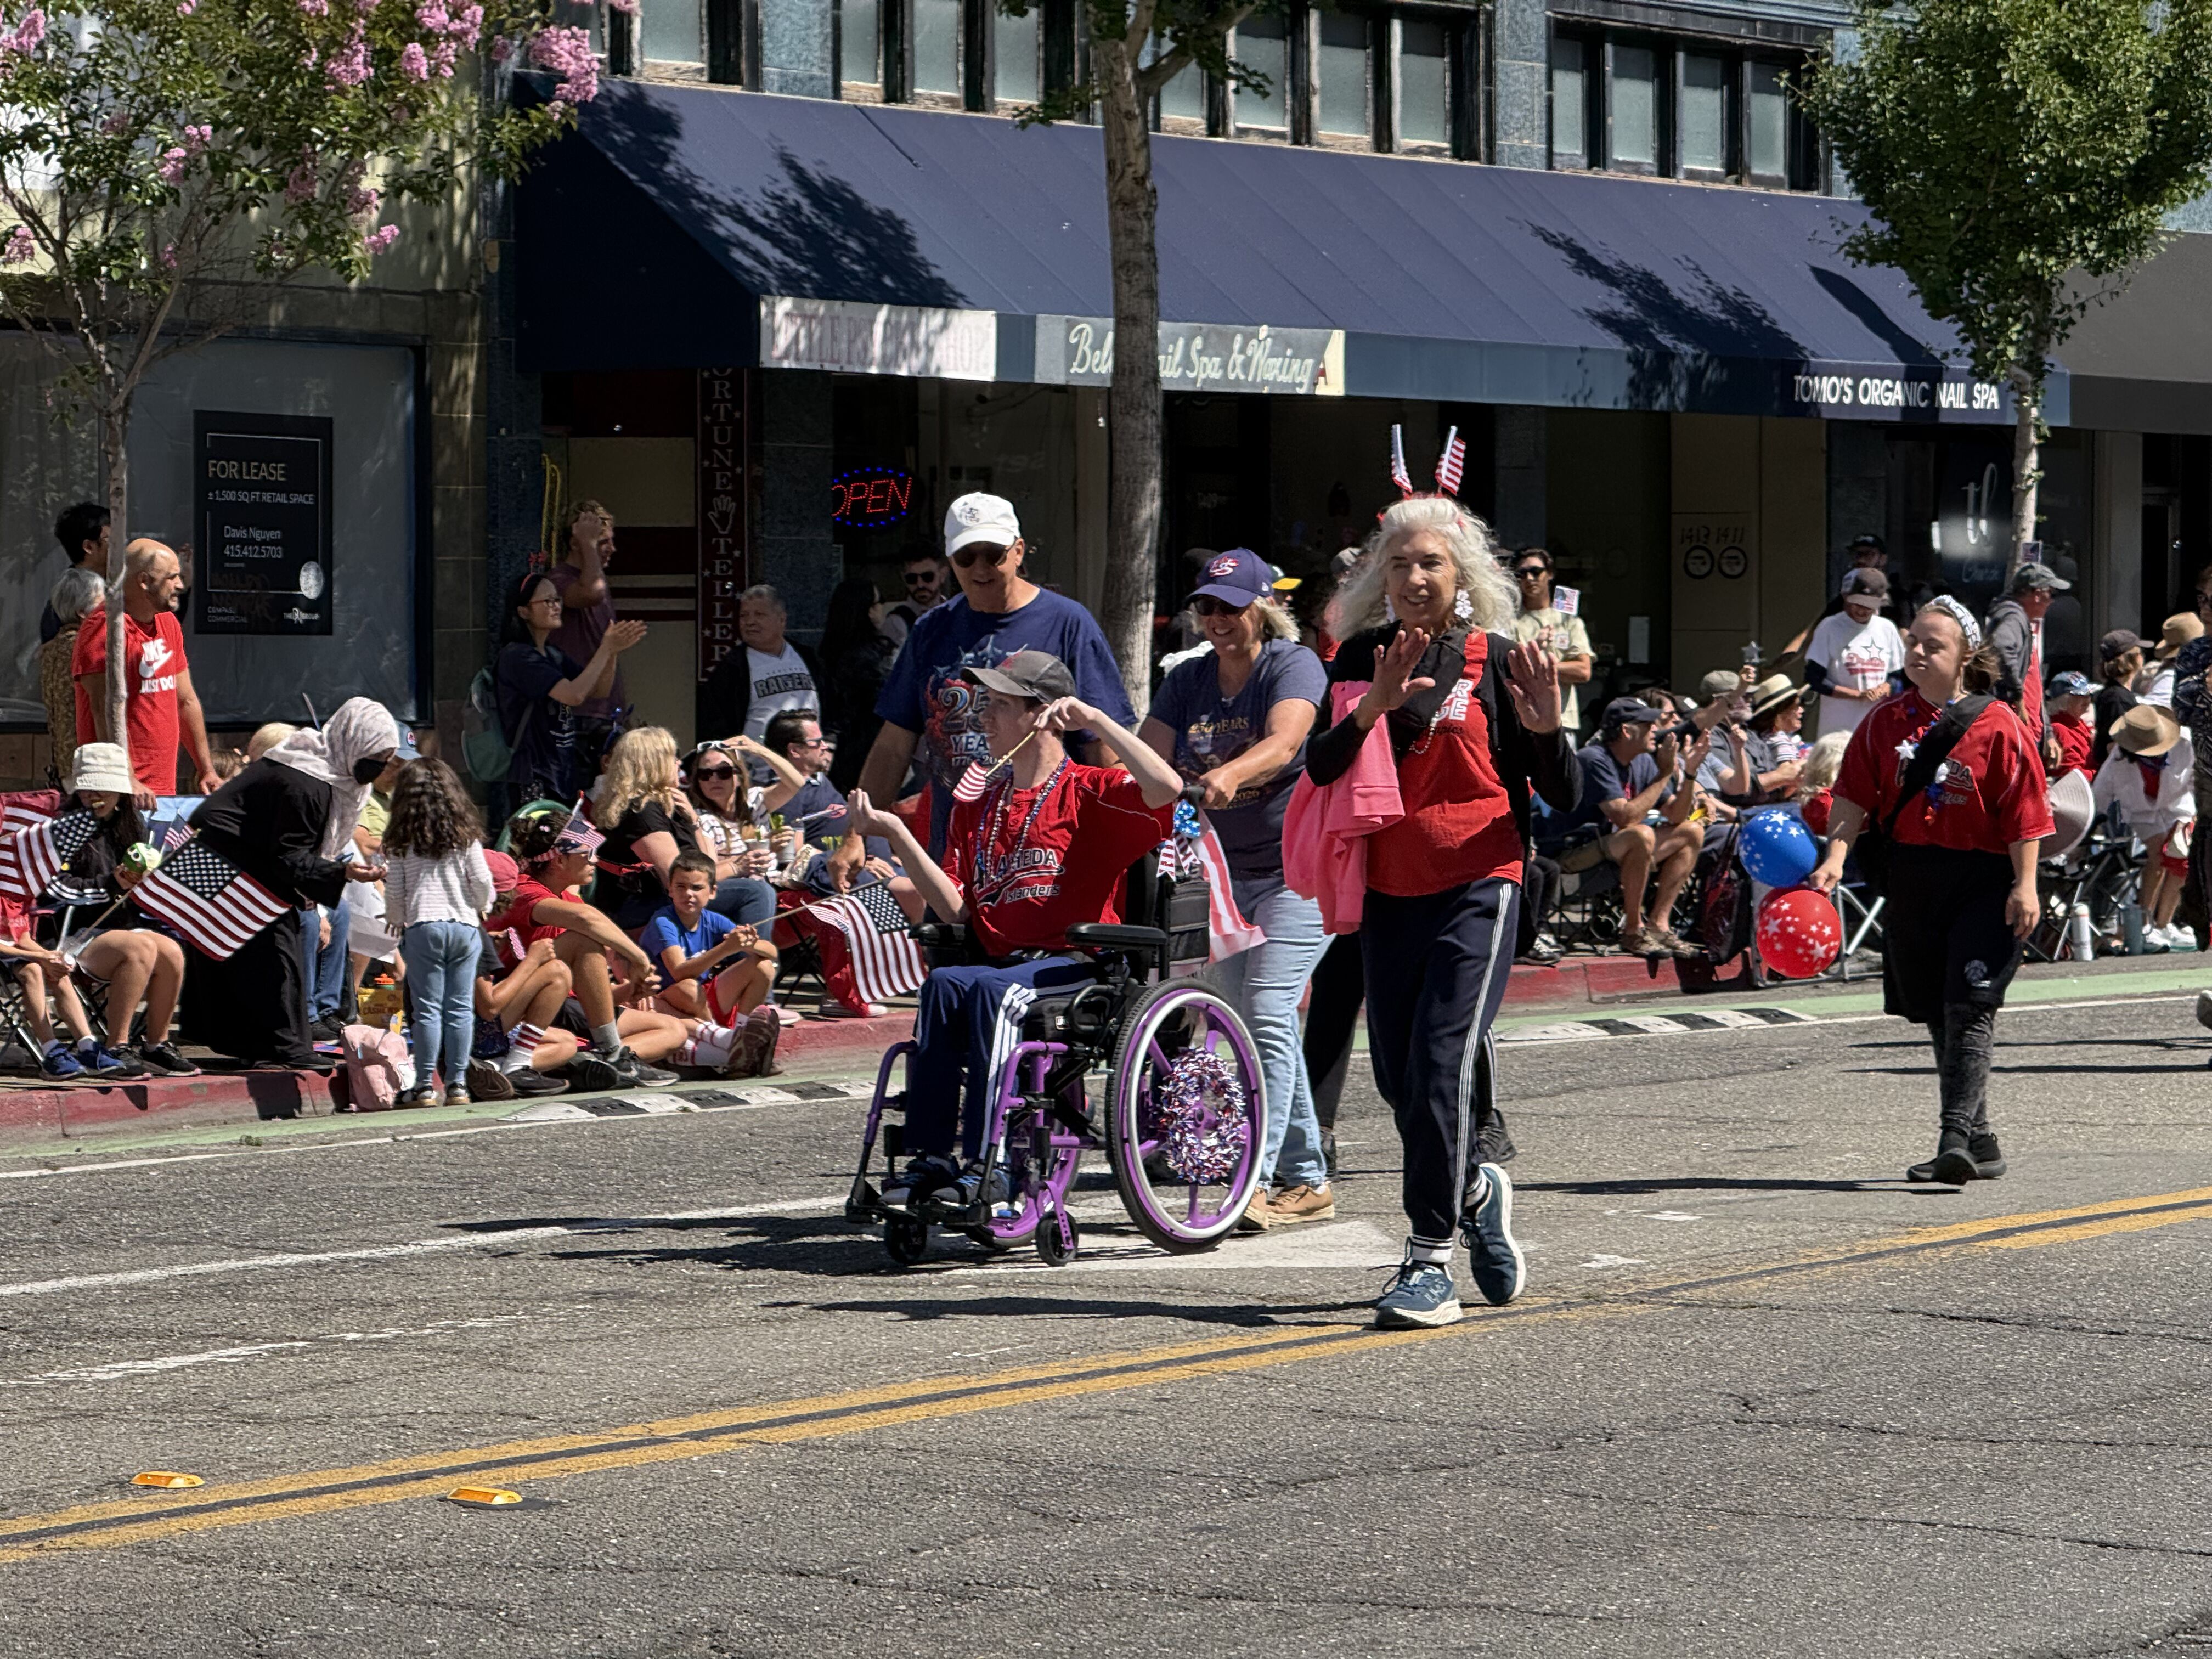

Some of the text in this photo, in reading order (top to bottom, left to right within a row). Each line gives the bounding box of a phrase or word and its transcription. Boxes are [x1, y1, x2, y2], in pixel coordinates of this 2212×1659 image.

[1158, 337, 1183, 378] ail
[1186, 335, 1222, 388] Spa
[1227, 333, 1246, 380] &
[1246, 335, 1315, 394] Waxing
[1793, 375, 2001, 410] TOMO'S ORGANIC NAIL SPA
[208, 460, 287, 482] FOR LEASE
[238, 490, 250, 504] SQ
[251, 492, 261, 501] FT
[262, 493, 288, 504] RETAIL
[289, 494, 315, 505] SPACE
[224, 526, 281, 541] Davis Nguyen
[224, 544, 283, 558] 415.412.5703
[711, 538, 733, 662] TELLER
[159, 675, 175, 691] DO
[950, 734, 990, 754] YEA
[973, 848, 1058, 890] AAEDA
[1005, 884, 1062, 904] Islanders
